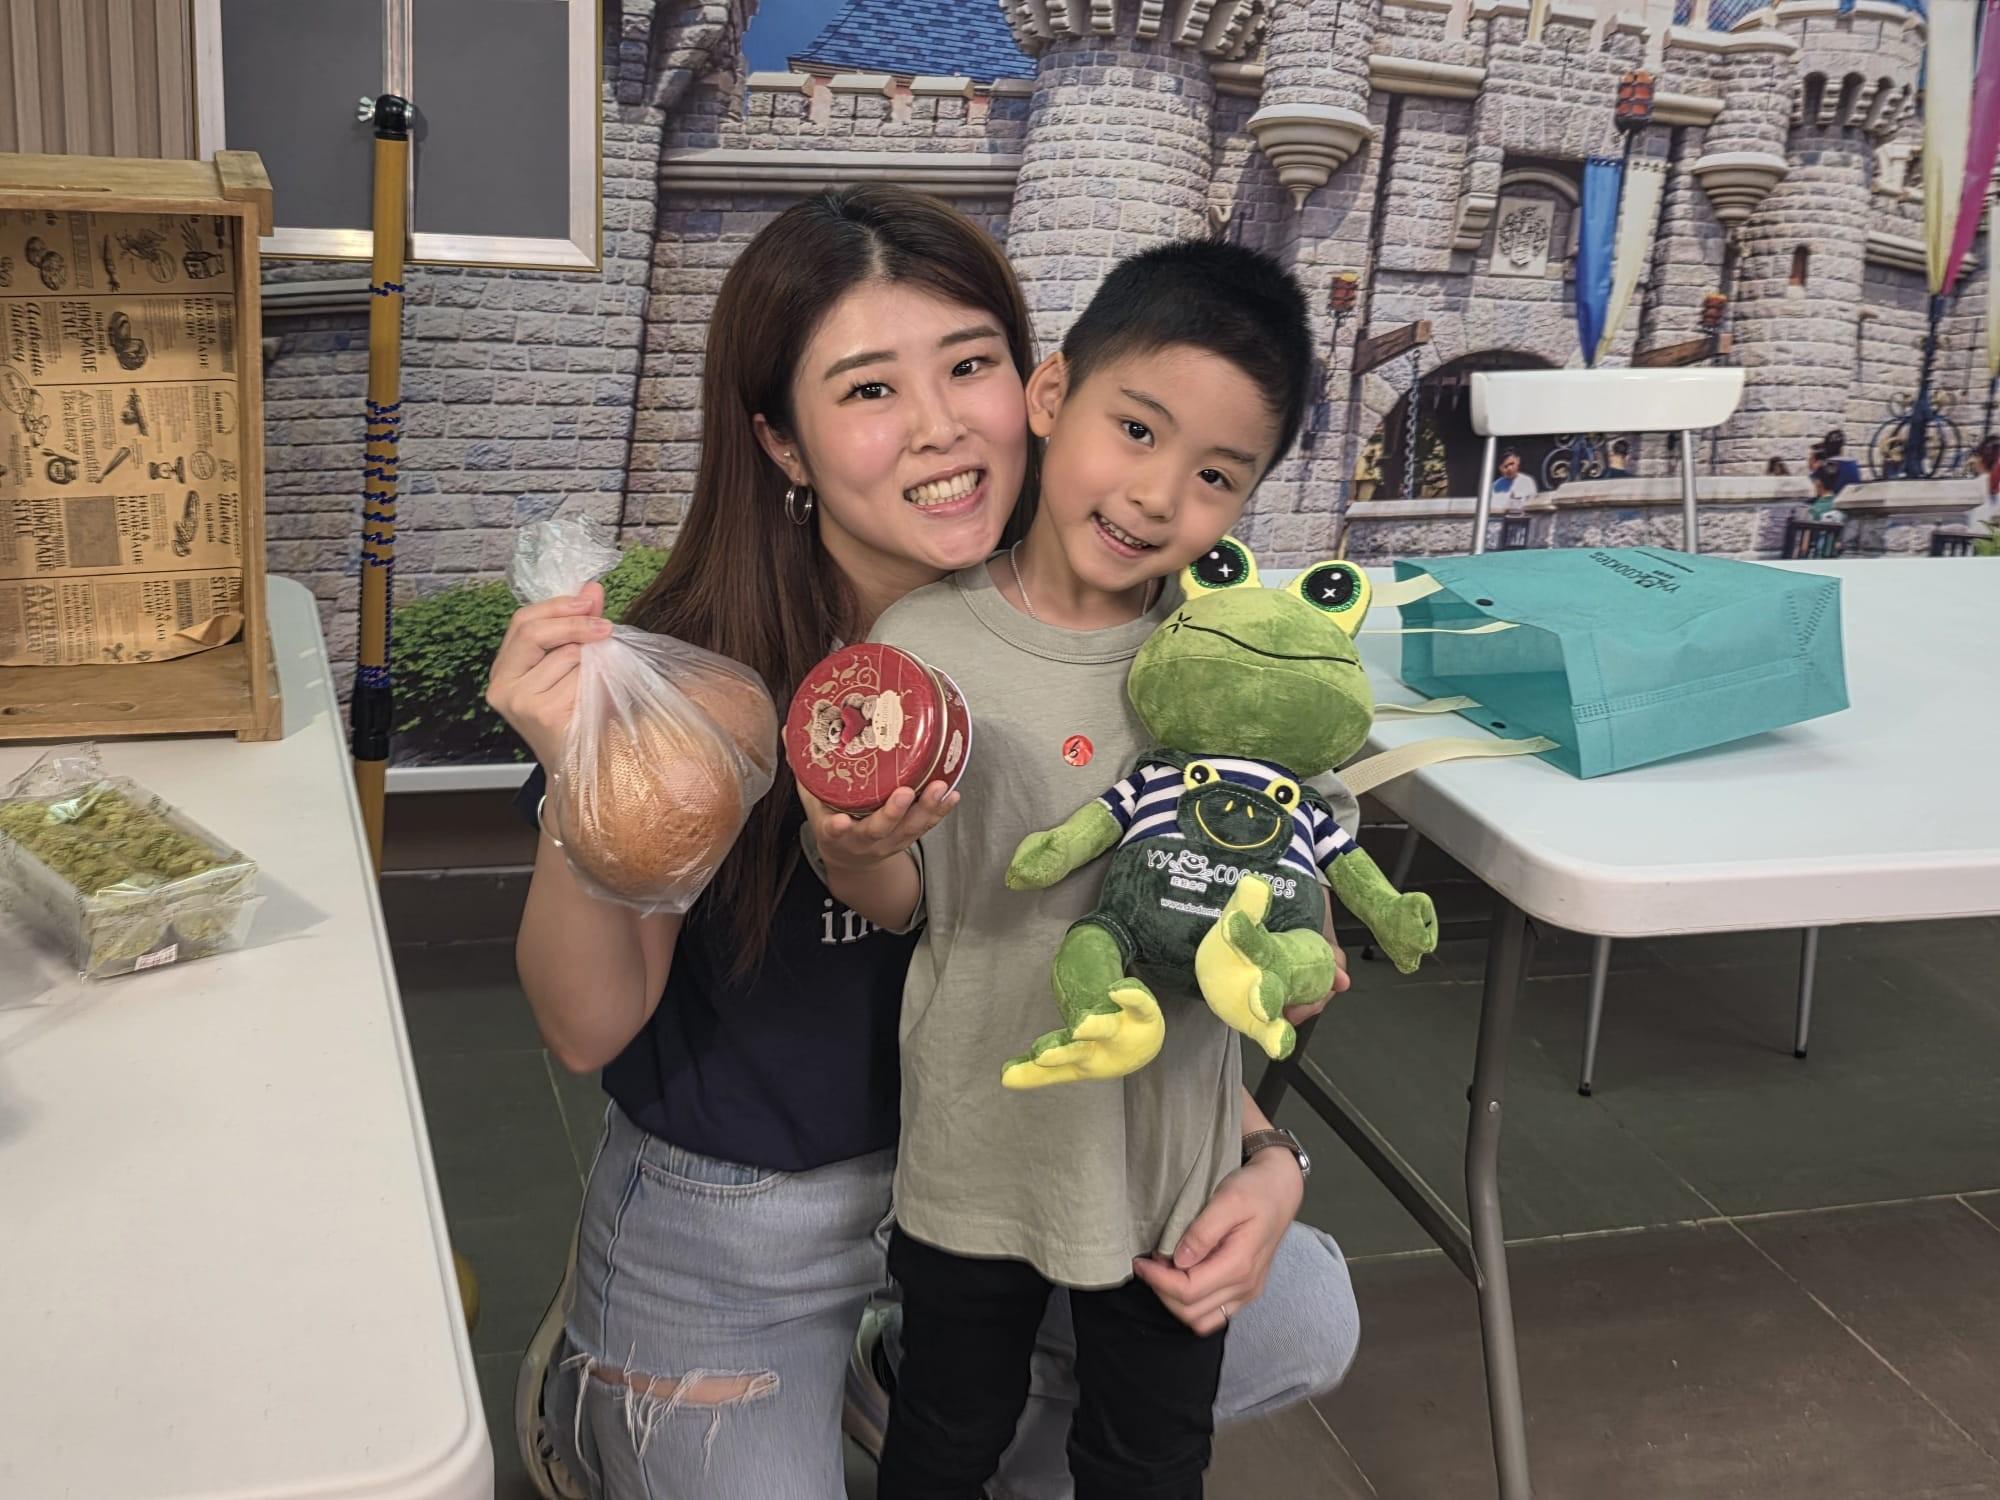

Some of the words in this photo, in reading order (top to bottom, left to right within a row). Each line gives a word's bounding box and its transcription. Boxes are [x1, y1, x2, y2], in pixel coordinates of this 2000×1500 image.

[25, 302, 45, 376] Authentic
[61, 302, 79, 340] STYLE
[76, 302, 97, 373] HOMEMADE
[183, 298, 196, 339] RECIPE
[194, 298, 209, 369] HOMEMADE
[13, 499, 35, 538] STYLE
[31, 499, 56, 572] HOMEMADE
[116, 496, 131, 537] RECIPE
[128, 496, 144, 565] HOMEMADE
